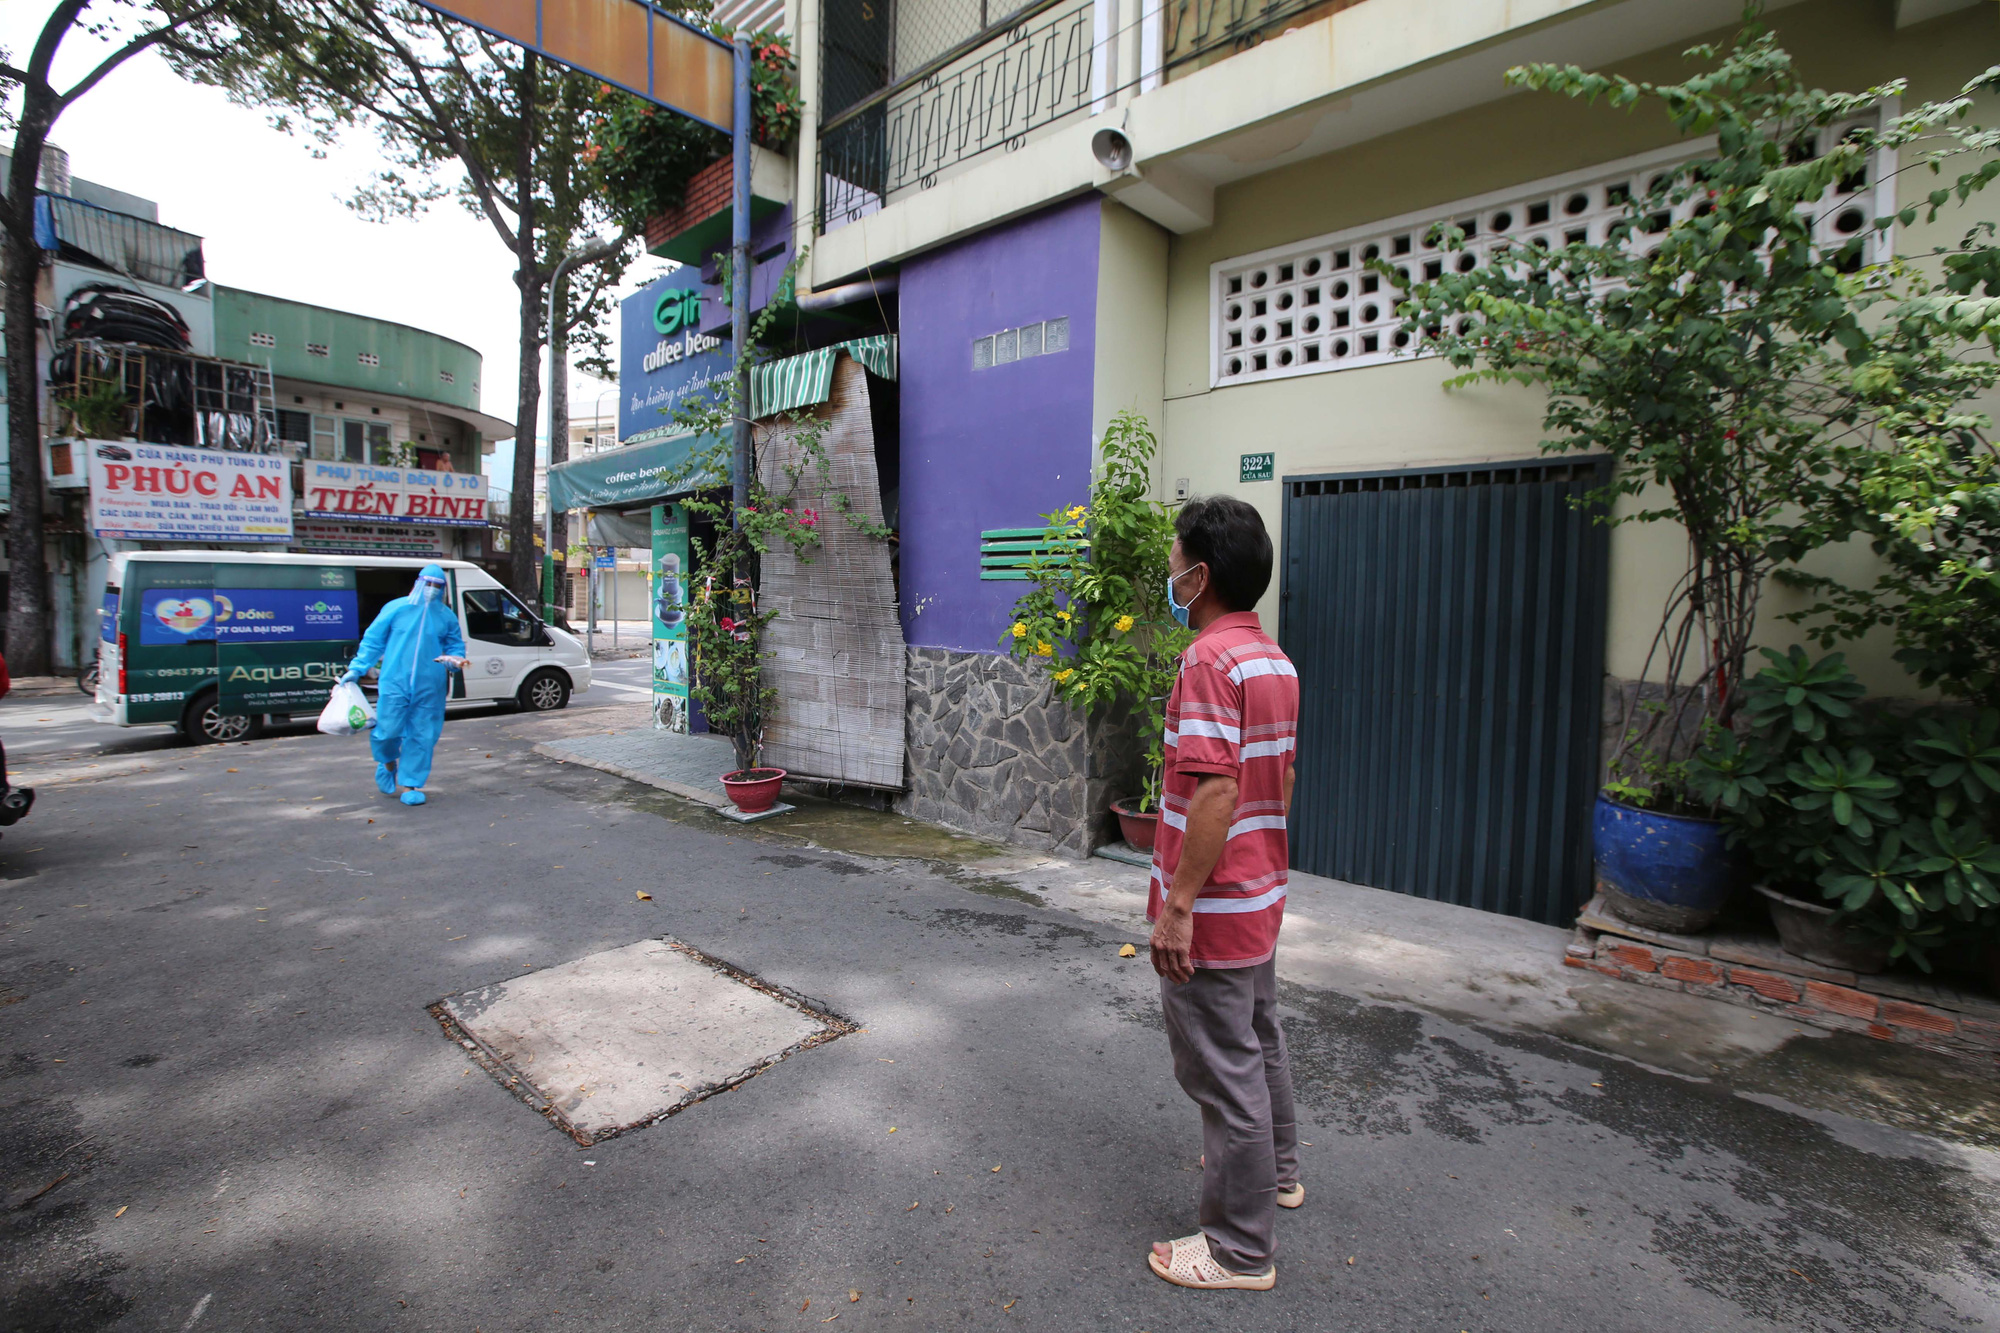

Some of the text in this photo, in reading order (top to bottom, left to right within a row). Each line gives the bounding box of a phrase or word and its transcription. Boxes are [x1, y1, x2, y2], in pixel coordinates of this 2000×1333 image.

[643, 339, 683, 373] coffee
[165, 450, 197, 462] HÀNG
[201, 454, 224, 466] PHỤ
[227, 455, 255, 467] TÙNG
[258, 458, 265, 468] Ô
[269, 459, 282, 469] TÔ
[1243, 455, 1271, 471] 322A
[103, 462, 281, 499] PHÚC AN
[316, 464, 479, 489] PHỤ TÙNG ĐÈN Ô TÔ
[605, 466, 667, 485] coffee bean
[150, 500, 171, 508] MUA
[200, 502, 221, 510] TRAO
[311, 483, 486, 519] TIẾN BÌNH
[342, 525, 373, 534] TIẾN
[377, 526, 408, 535] BÌNH
[236, 608, 275, 620] ĐỒNG
[304, 601, 343, 613] NOVA
[230, 626, 253, 634] QUA
[253, 625, 270, 635] ĐẠI
[271, 625, 295, 634] DỊCH
[157, 668, 188, 677] 0943
[189, 667, 205, 676] 79
